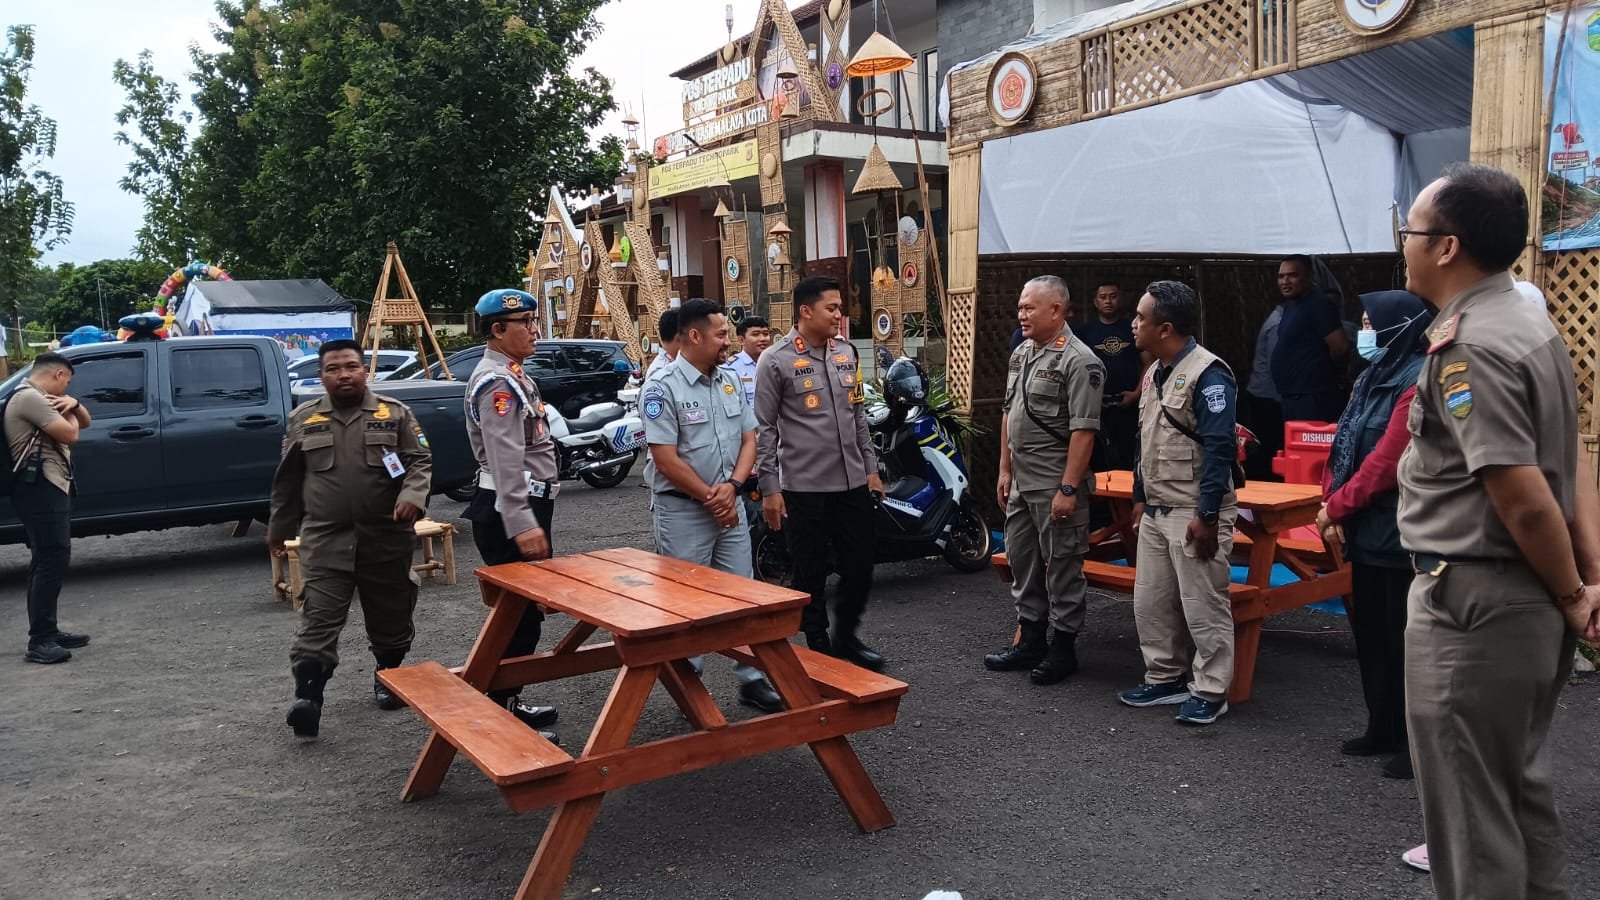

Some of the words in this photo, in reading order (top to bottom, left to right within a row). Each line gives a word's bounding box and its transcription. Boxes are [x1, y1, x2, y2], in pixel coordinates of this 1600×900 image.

[703, 56, 751, 94] TERPADU
[745, 105, 768, 127] KOTA
[661, 165, 672, 175] POS
[672, 157, 698, 171] TERPADU
[795, 367, 815, 377] ANDI
[681, 400, 699, 409] IDO
